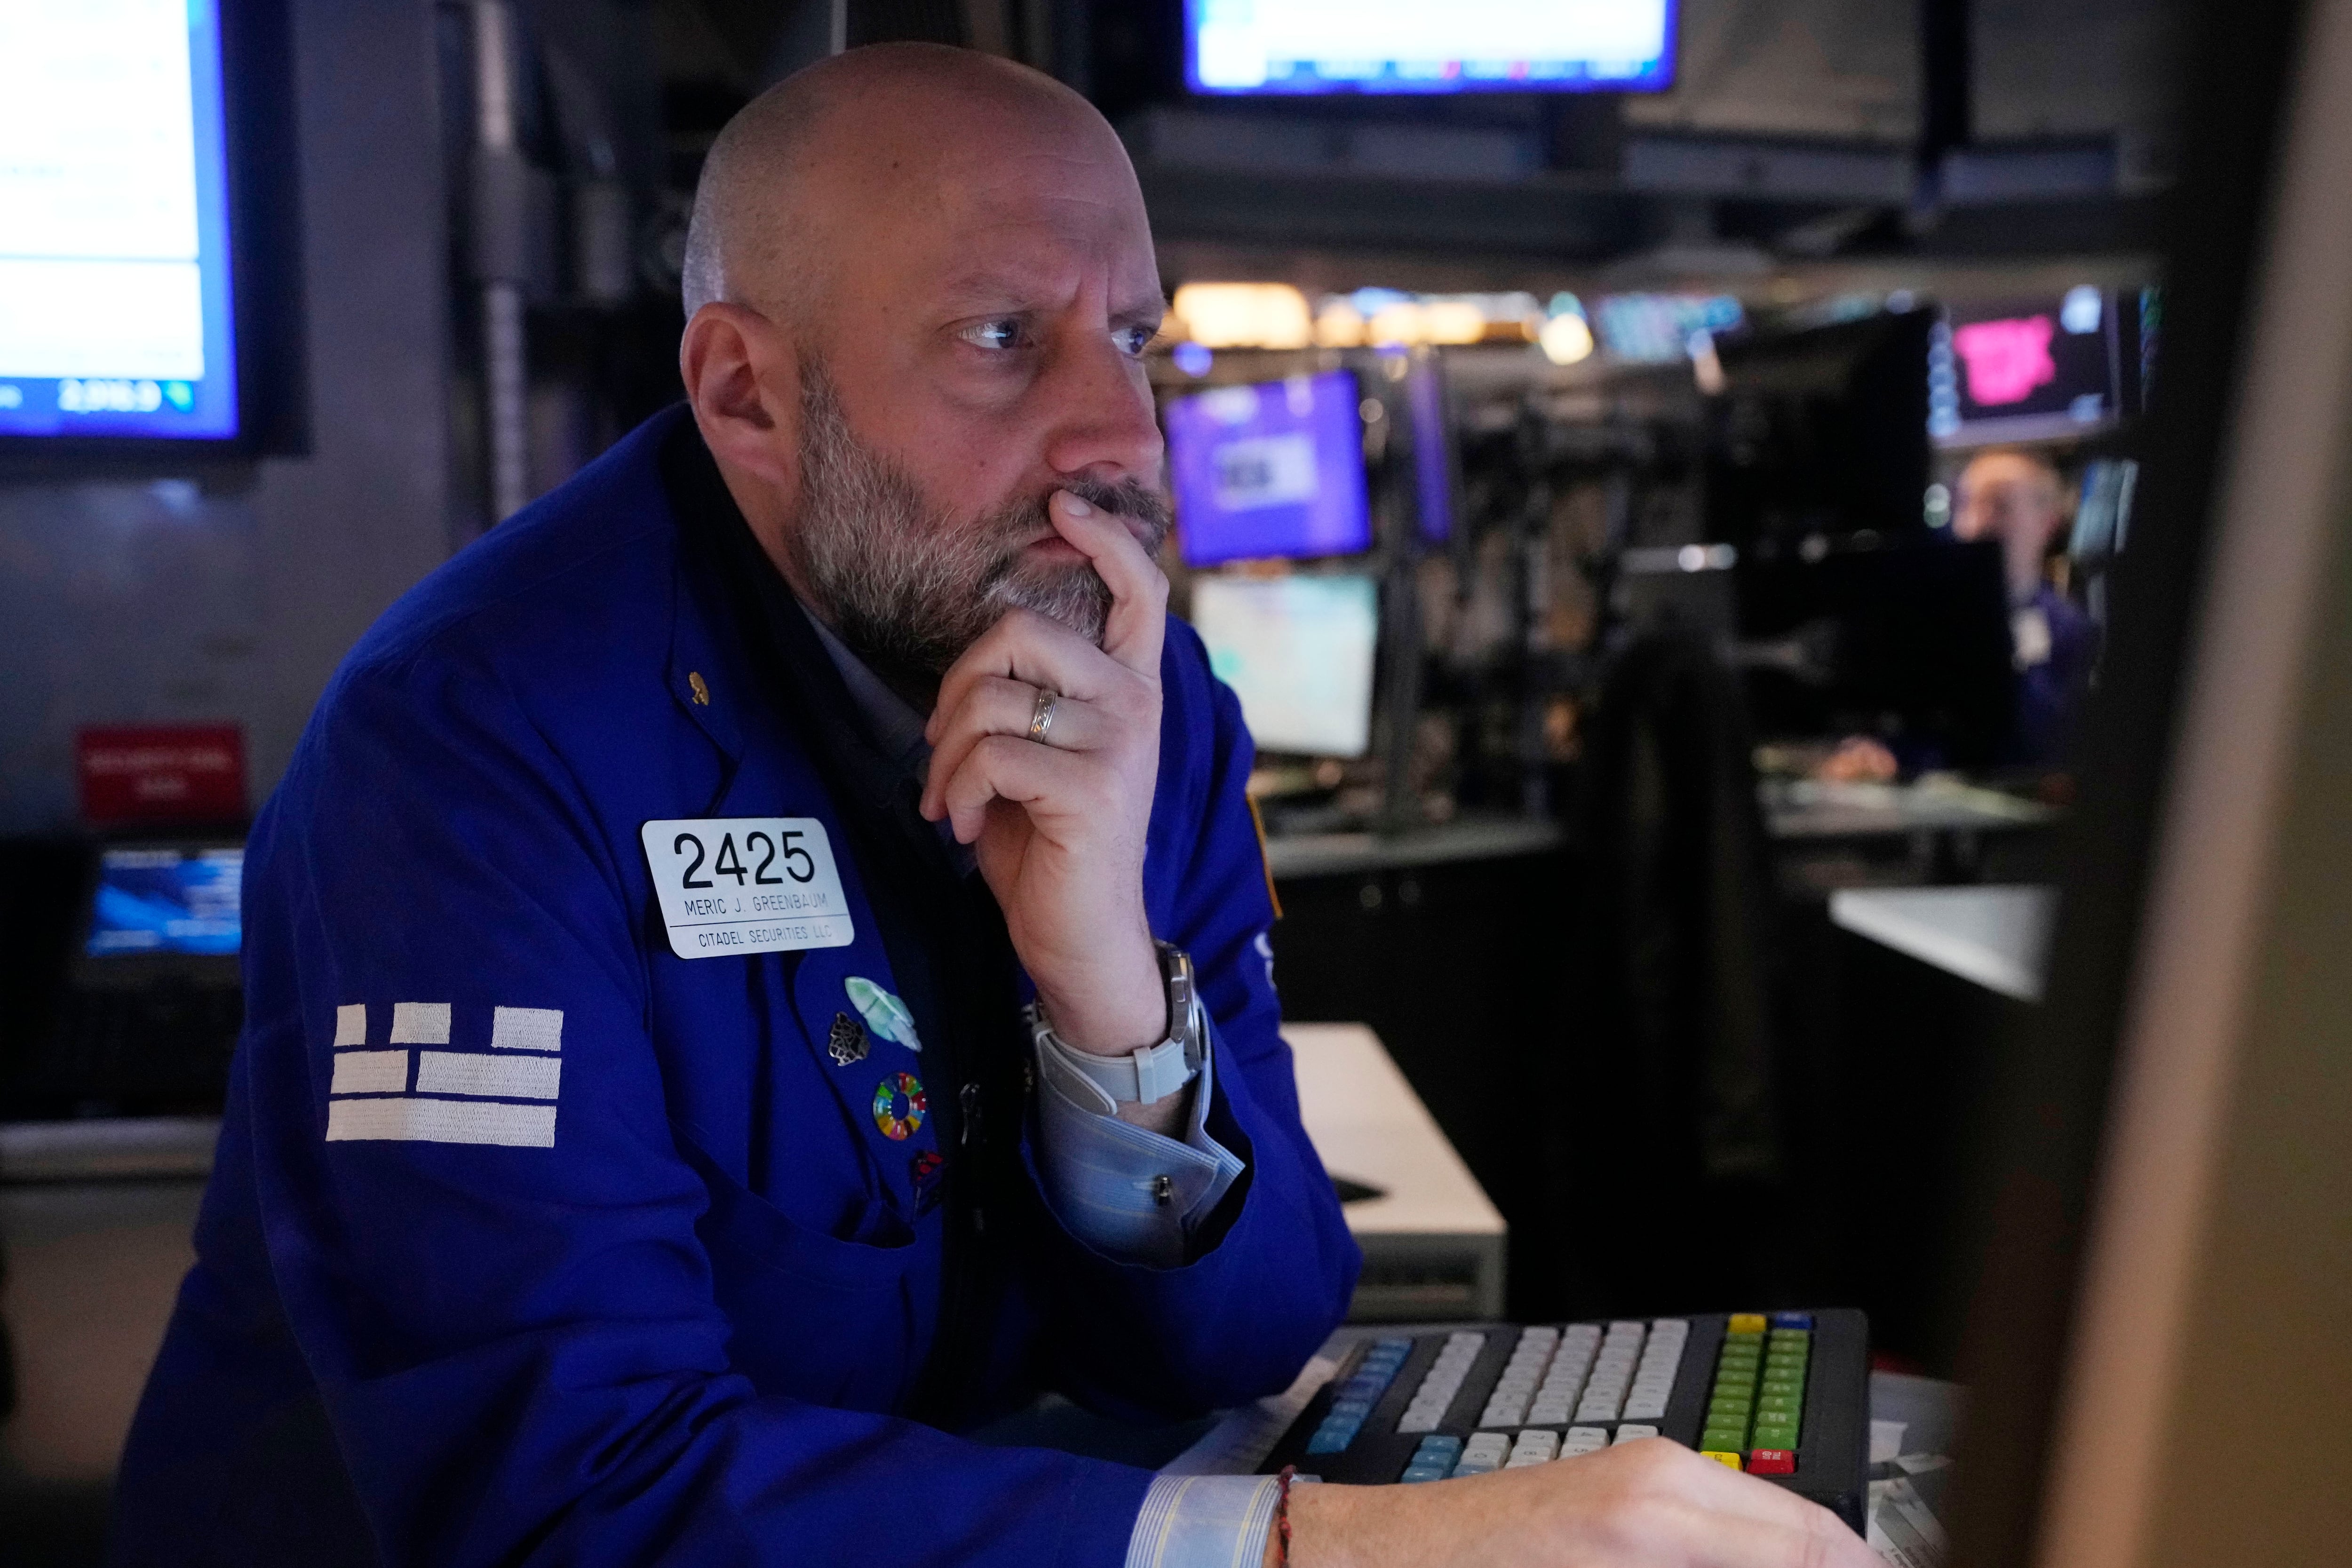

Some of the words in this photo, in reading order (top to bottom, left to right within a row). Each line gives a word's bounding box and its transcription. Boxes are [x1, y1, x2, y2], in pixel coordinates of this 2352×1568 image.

[674, 831, 814, 889] 2425
[685, 899, 727, 915] MERIC
[735, 898, 746, 912] J.
[753, 893, 828, 912] GREENBAUM
[699, 931, 744, 947] CITADEL
[749, 926, 808, 943] SECURITIES
[814, 925, 833, 938] LLC
